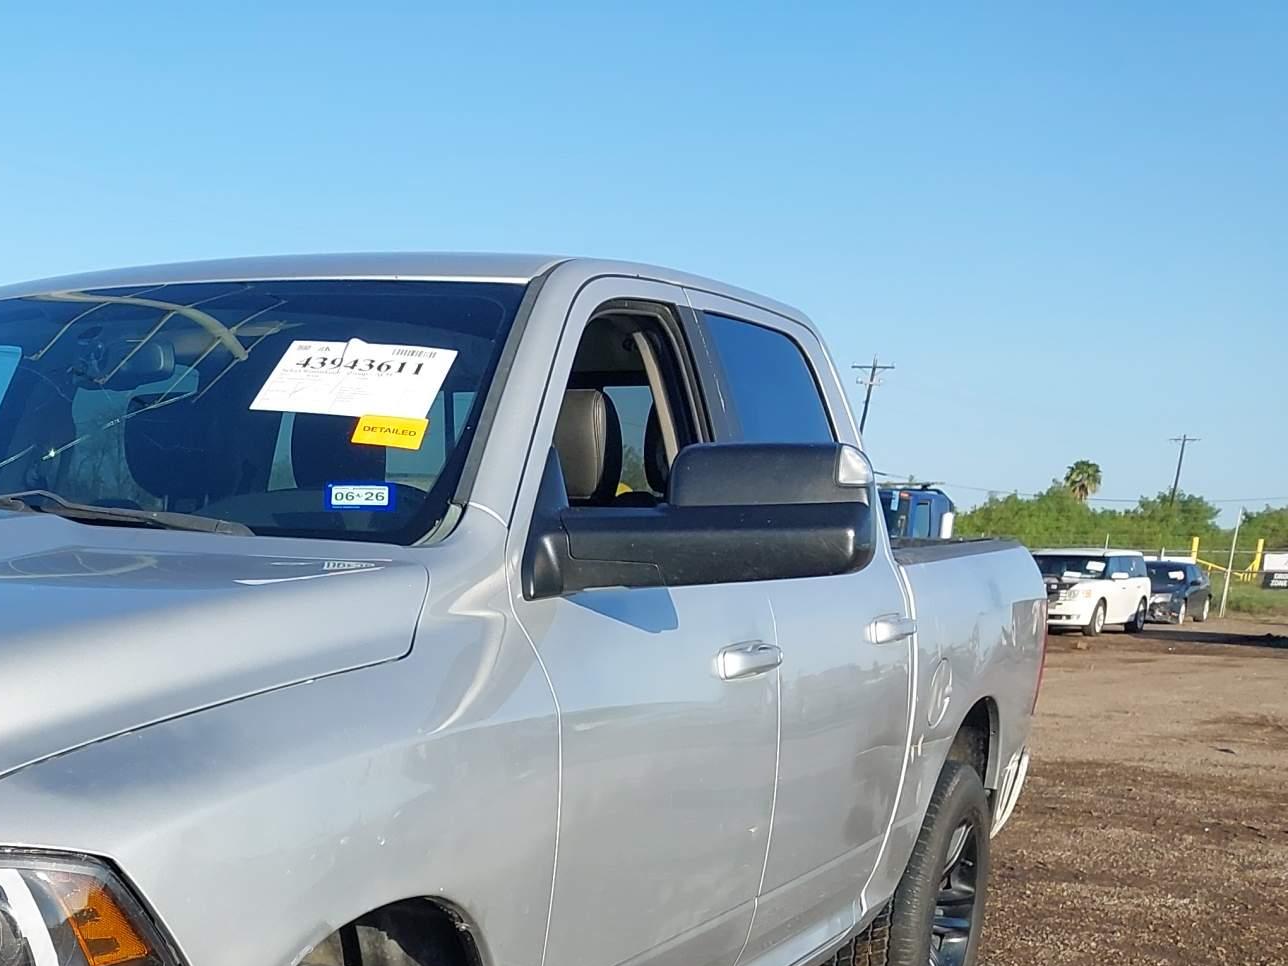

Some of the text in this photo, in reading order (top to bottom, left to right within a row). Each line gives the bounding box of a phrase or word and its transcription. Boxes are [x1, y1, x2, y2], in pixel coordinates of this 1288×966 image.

[295, 355, 425, 376] 43943611
[362, 425, 418, 437] DETAILED
[334, 491, 385, 502] 06 26
